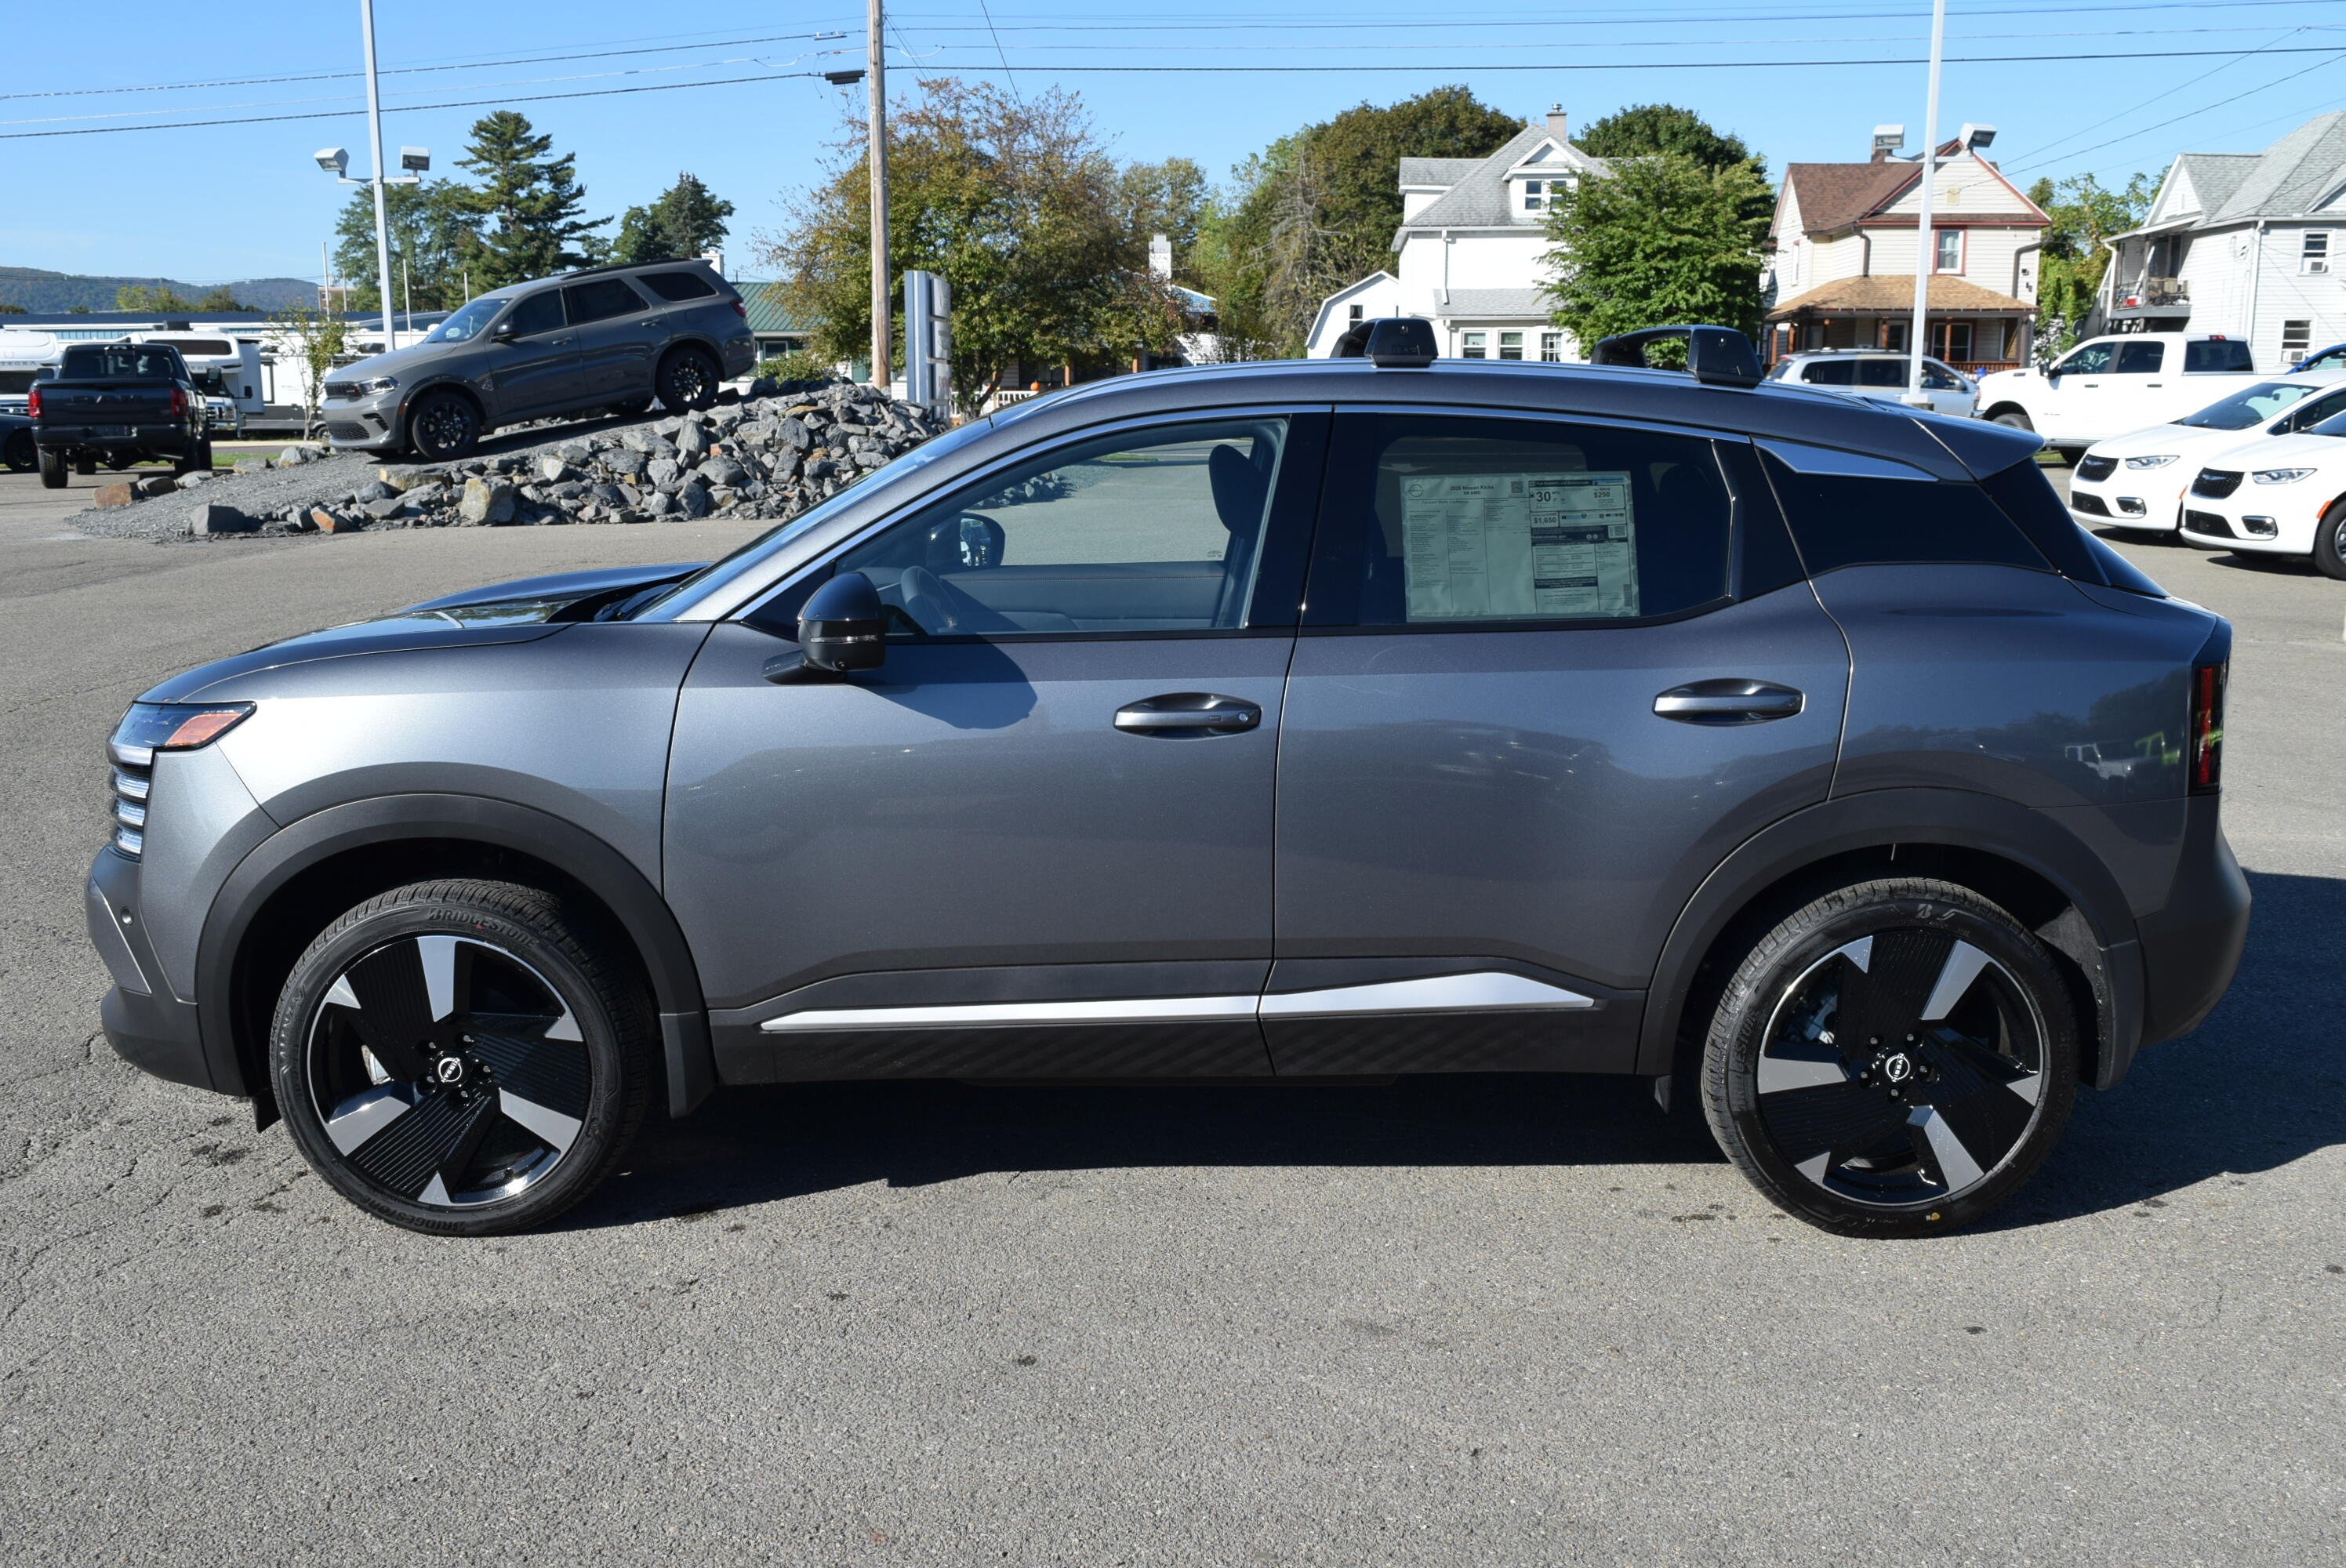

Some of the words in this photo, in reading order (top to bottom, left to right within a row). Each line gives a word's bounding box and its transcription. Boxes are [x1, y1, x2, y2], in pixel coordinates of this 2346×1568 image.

[1536, 491, 1551, 503] 30
[1534, 516, 1556, 524] $1,650
[427, 906, 540, 949] BRIDGESTONE
[441, 1057, 461, 1083] NISSAN
[1890, 1052, 1905, 1083] NISSAN
[358, 1195, 467, 1233] BRIDGESTONE
